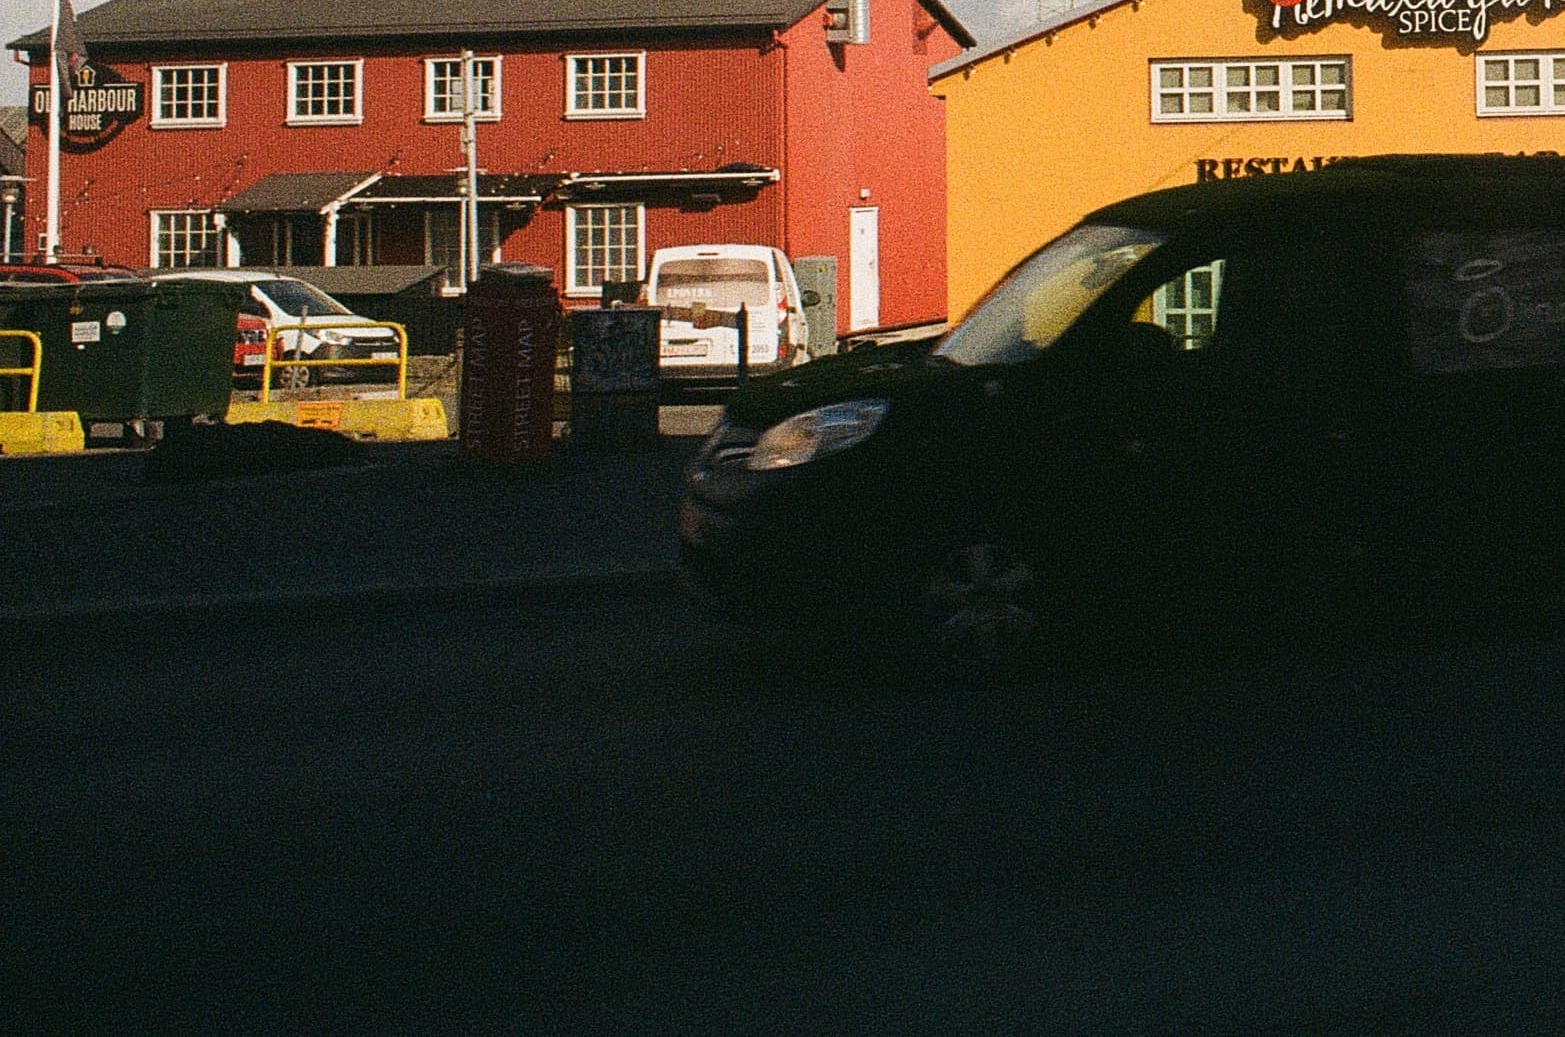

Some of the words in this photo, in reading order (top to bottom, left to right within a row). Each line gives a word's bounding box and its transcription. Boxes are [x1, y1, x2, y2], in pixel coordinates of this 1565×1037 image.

[1399, 9, 1472, 35] SPICE
[67, 89, 137, 113] HARBOUR
[68, 114, 102, 131] HOUSE
[517, 318, 535, 369] MAP
[514, 374, 533, 451] STREET
